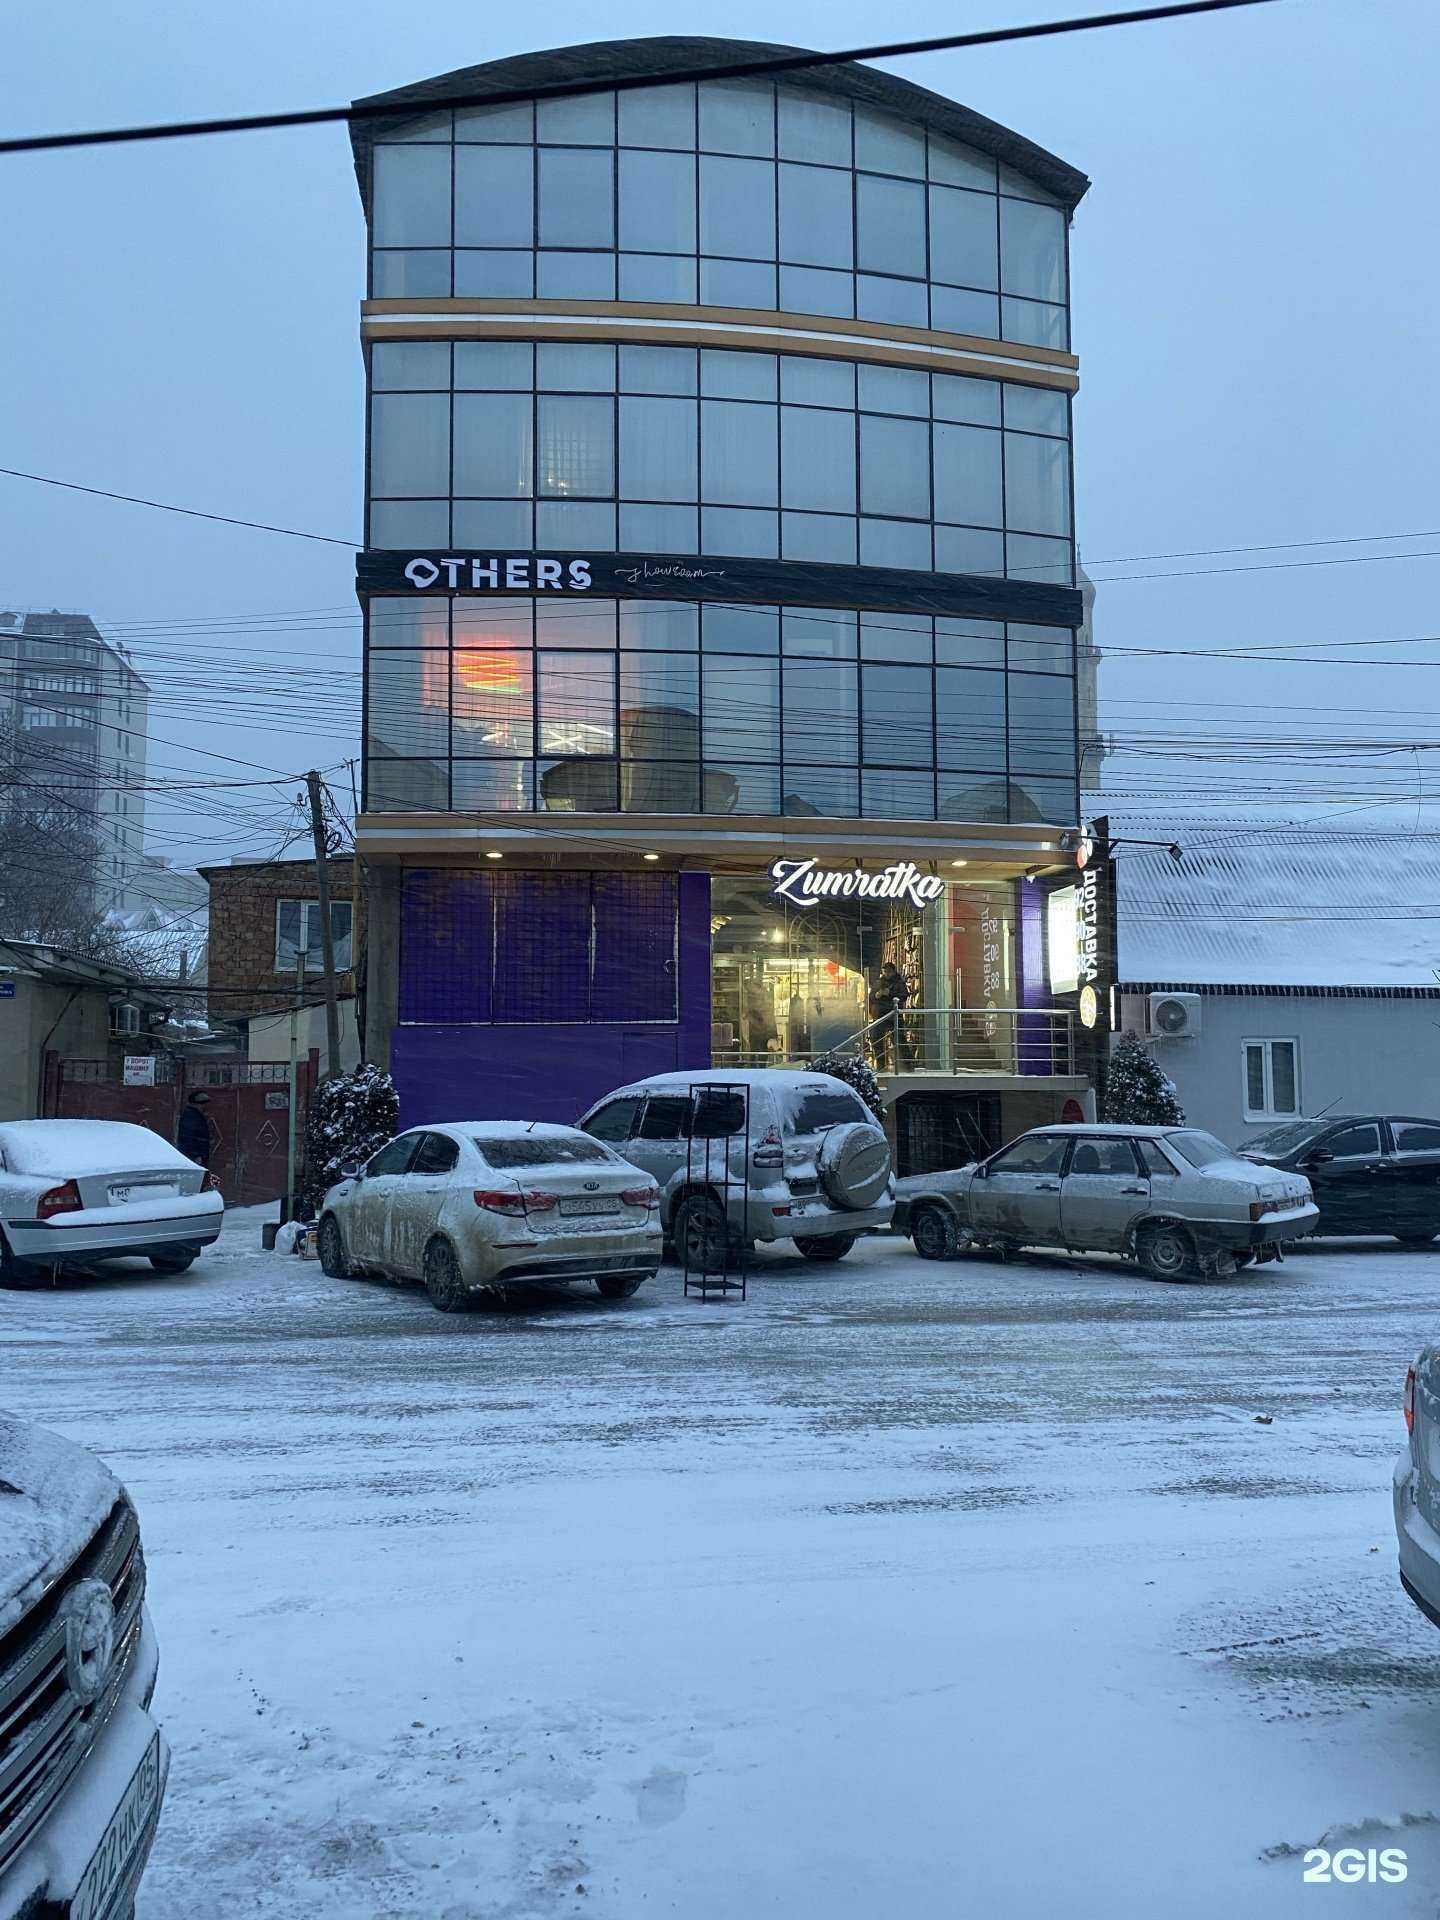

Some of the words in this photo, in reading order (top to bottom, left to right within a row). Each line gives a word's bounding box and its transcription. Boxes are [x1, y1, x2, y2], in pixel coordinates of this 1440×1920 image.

[404, 557, 592, 590] OTHERS
[772, 857, 945, 908] Zumratka
[1082, 870, 1097, 982] ДОСТАВКА
